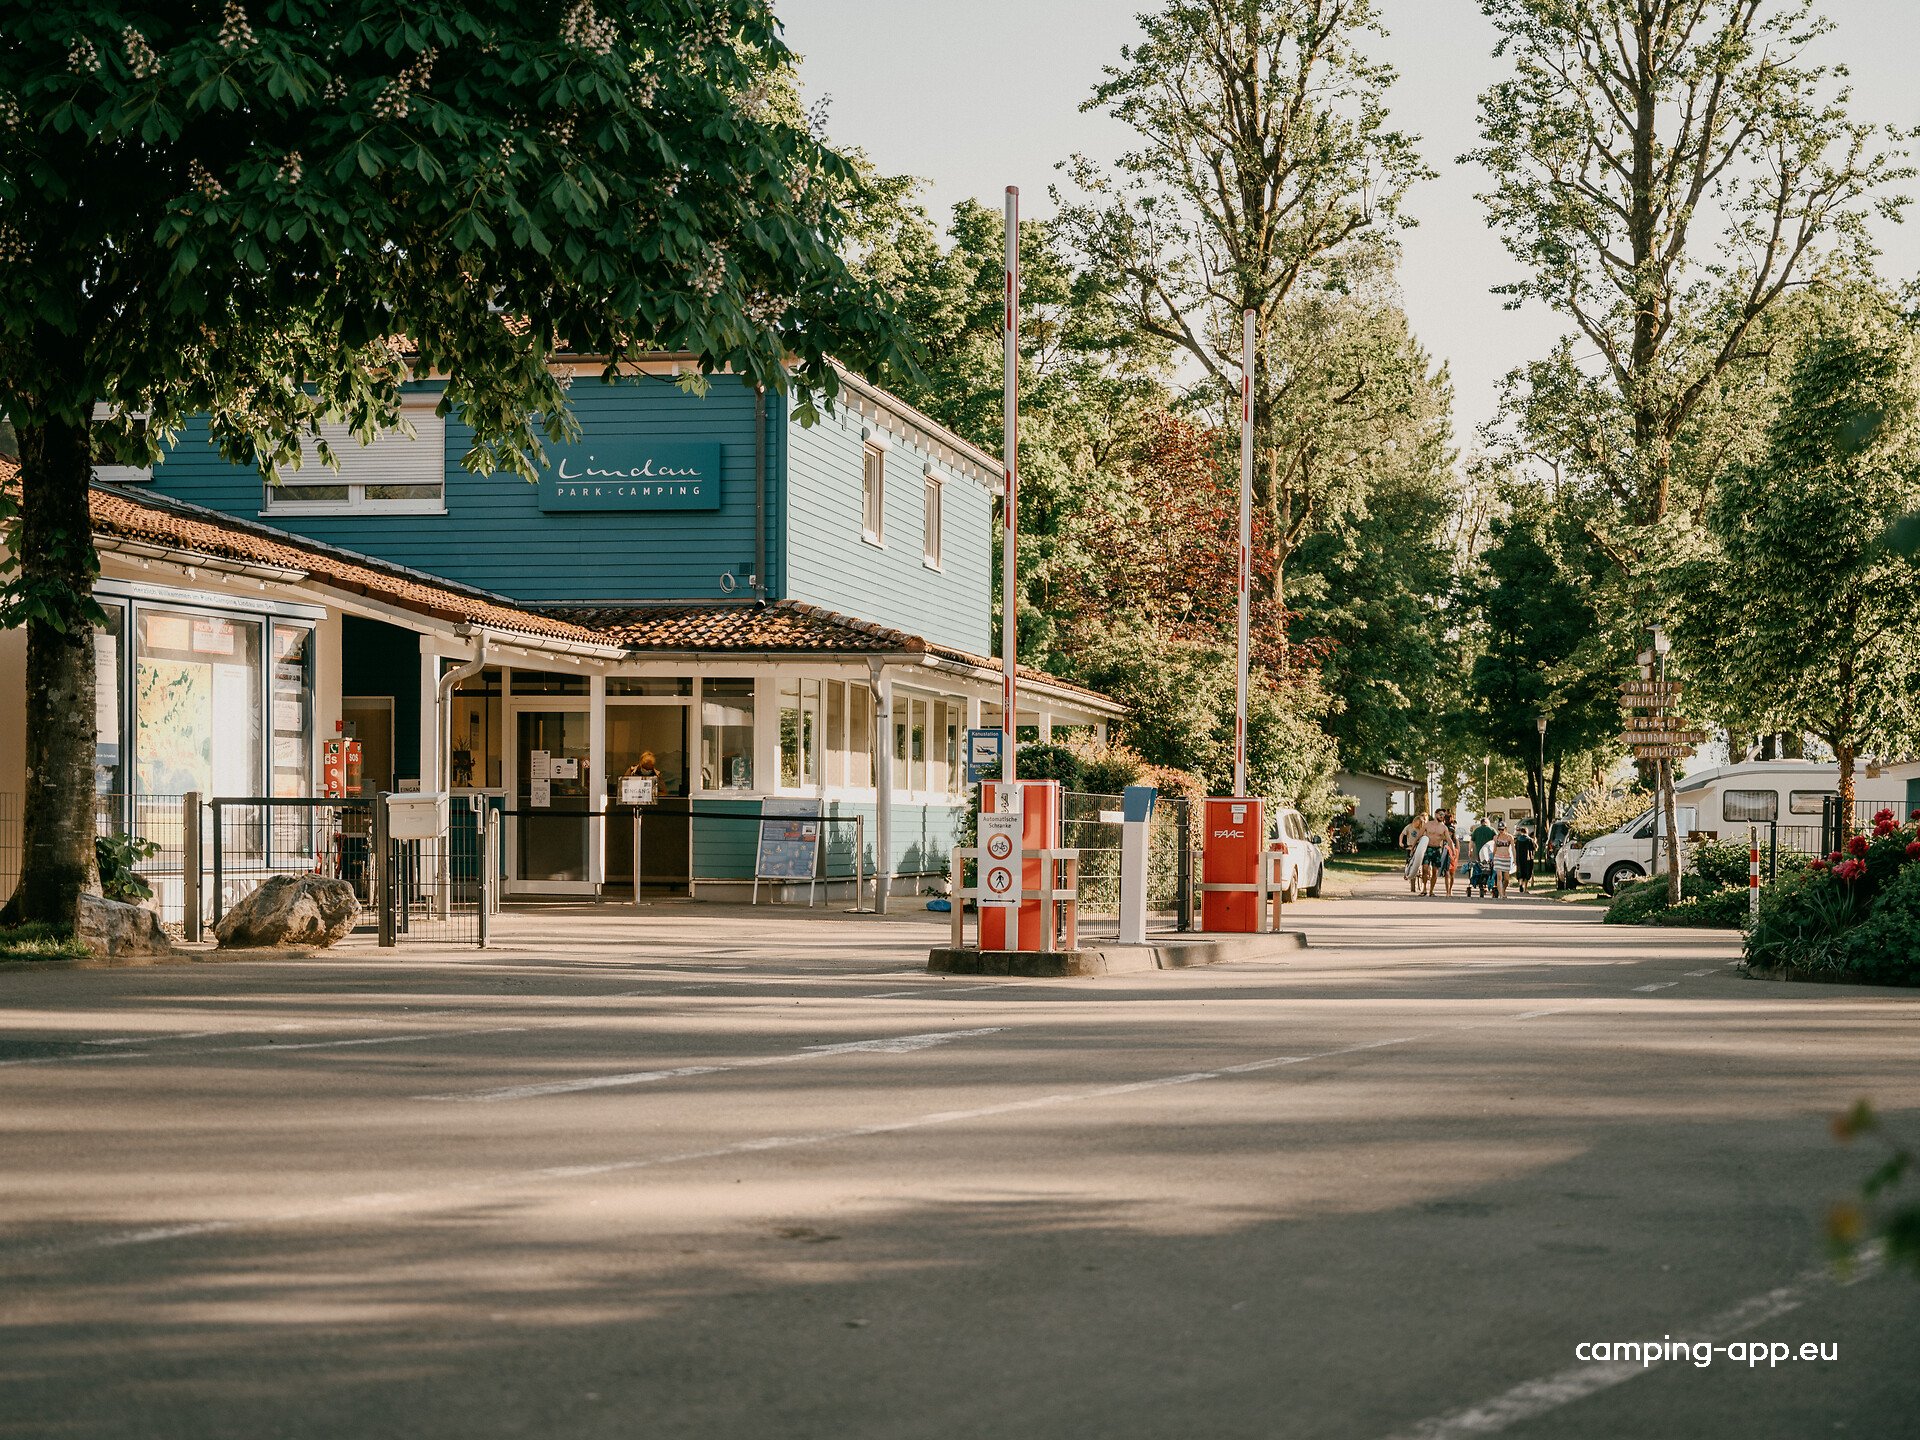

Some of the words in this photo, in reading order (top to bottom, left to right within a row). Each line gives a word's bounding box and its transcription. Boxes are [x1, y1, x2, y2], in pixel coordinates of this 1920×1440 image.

[558, 455, 701, 479] Lindau
[558, 487, 700, 496] PARK-CAMPING
[1634, 718, 1678, 728] Fussball
[1689, 733, 1701, 742] WC
[349, 753, 359, 762] SOS
[1214, 830, 1245, 838] FAAC
